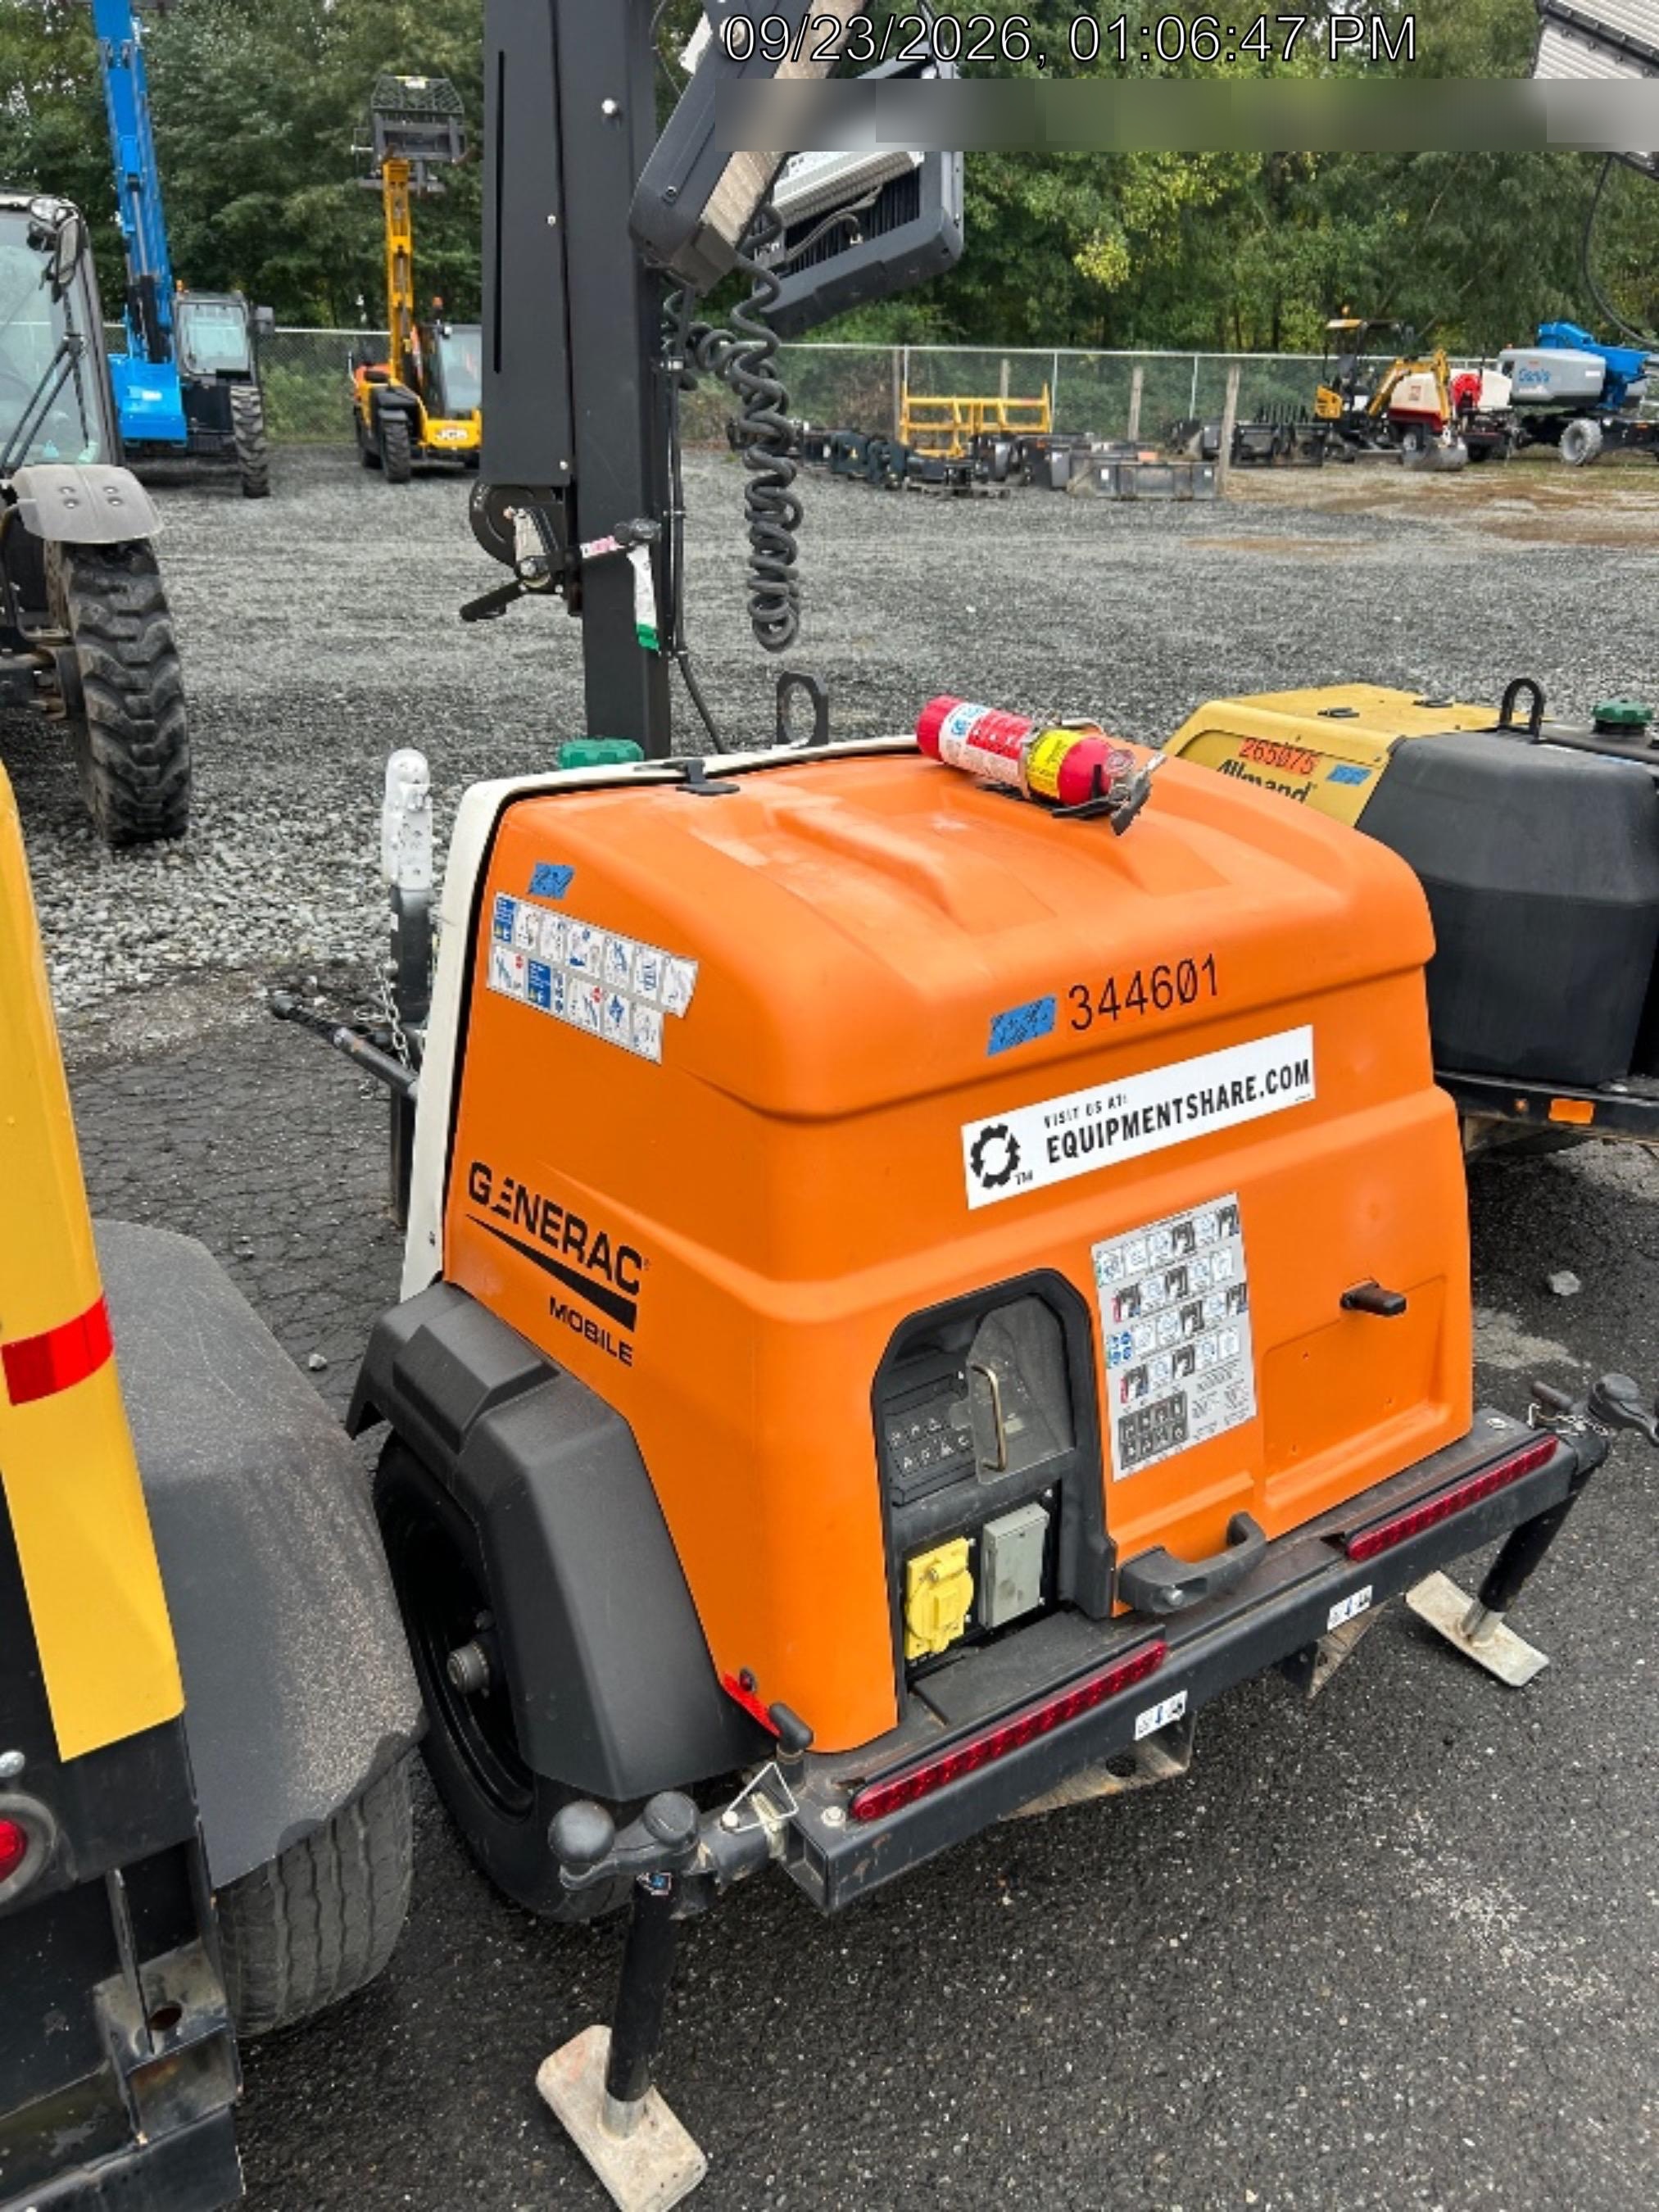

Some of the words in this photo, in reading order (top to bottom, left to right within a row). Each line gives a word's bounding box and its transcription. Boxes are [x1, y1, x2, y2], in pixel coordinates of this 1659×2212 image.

[1217, 759, 1311, 804] Allmand
[1238, 737, 1318, 775] 265075
[1068, 953, 1217, 1031] 344601
[1045, 1105, 1079, 1129] VISIT
[1086, 1100, 1102, 1117] US
[1108, 1093, 1126, 1110] AT:
[1046, 1059, 1311, 1163] EQUIPMENTSHARE.COM
[469, 1161, 643, 1296] GENERAC
[549, 1295, 633, 1367] MOBILE
